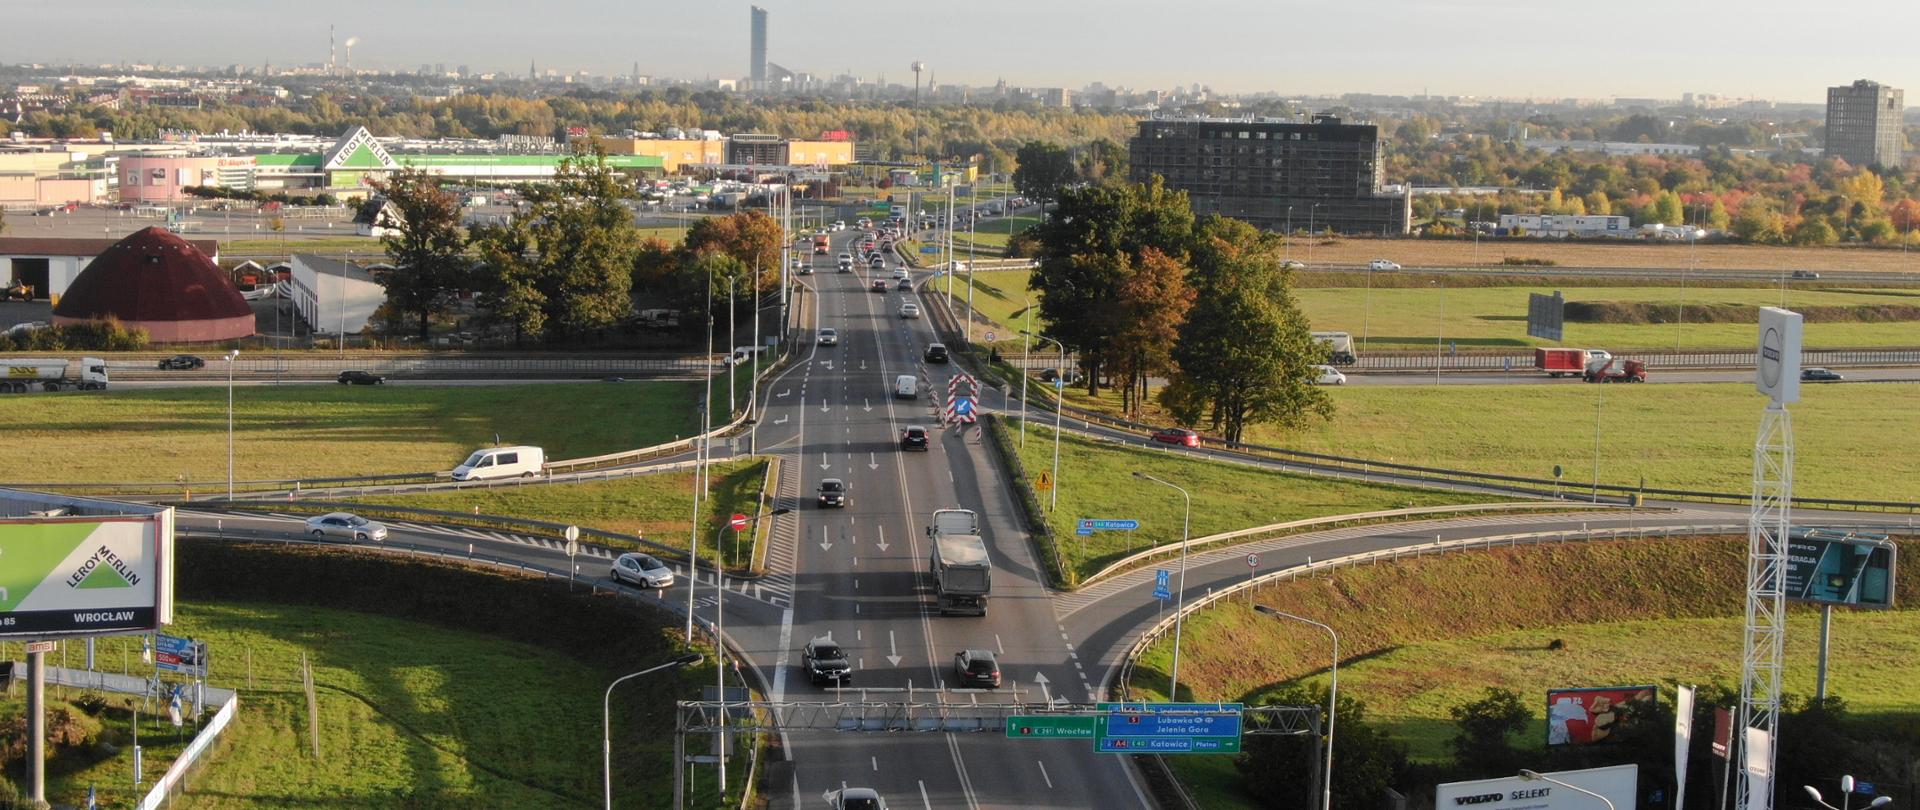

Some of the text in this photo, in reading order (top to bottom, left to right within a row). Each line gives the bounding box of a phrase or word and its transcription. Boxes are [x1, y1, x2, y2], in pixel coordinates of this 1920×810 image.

[334, 129, 391, 166] LEROY MERLIN
[66, 545, 141, 588] LEROY MERLIN
[4, 617, 16, 625] 85
[74, 611, 135, 623] WROCŁAW
[30, 642, 51, 651] ams
[1151, 740, 1188, 748] Katowice
[1455, 787, 1551, 805] VOLVO SELEKT
